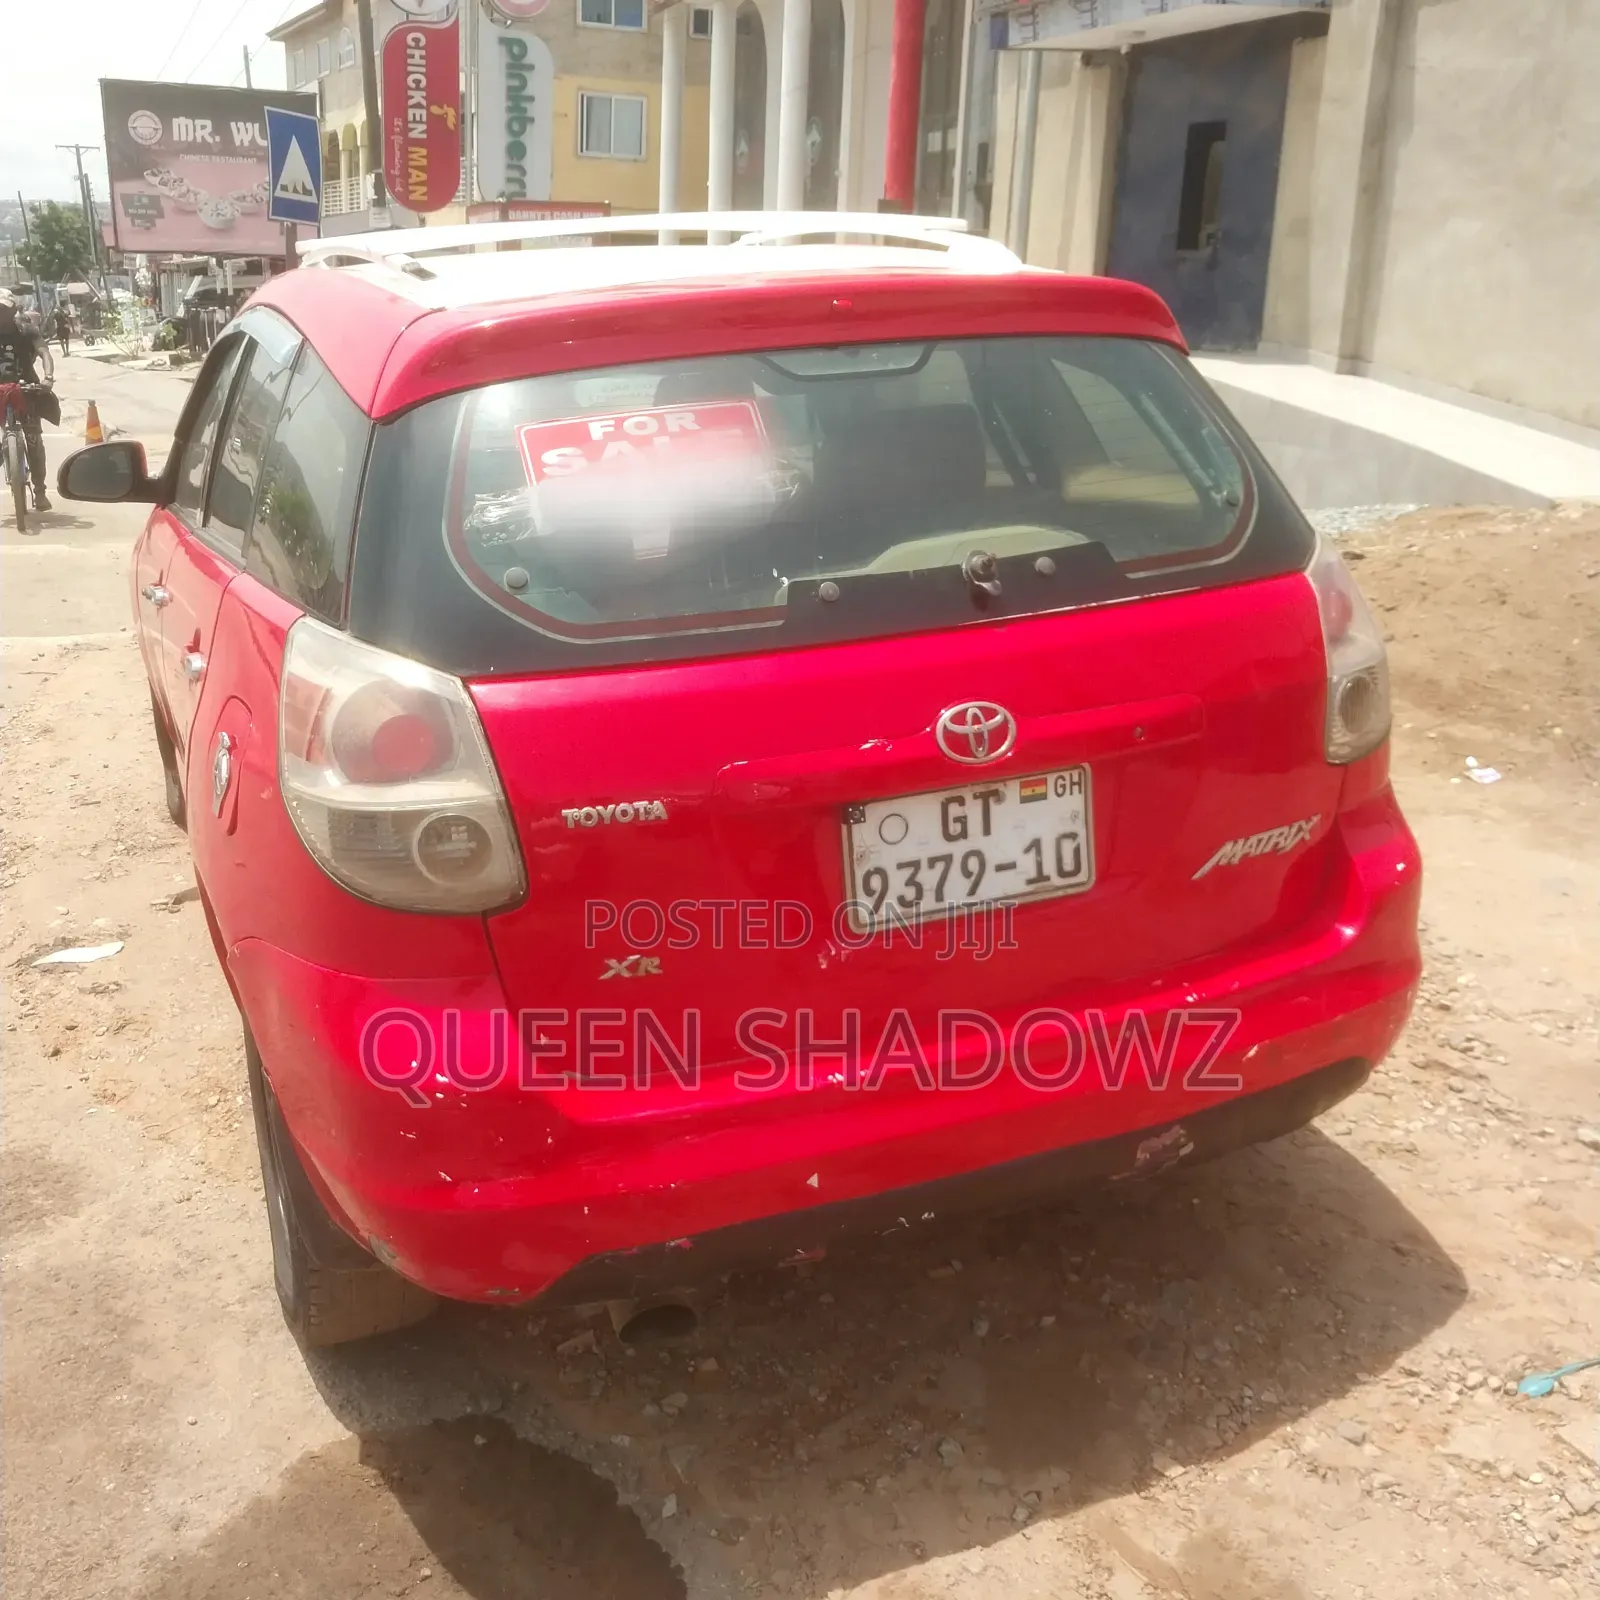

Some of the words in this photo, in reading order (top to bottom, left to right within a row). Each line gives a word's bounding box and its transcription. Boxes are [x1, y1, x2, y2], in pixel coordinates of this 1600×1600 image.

[406, 32, 427, 139] CHICKEN
[172, 116, 220, 144] MR.
[407, 147, 428, 201] MAN
[588, 412, 701, 441] FOR
[1054, 772, 1083, 798] GH
[562, 801, 668, 828] TOYOTA
[941, 789, 1000, 842] GT
[1191, 813, 1321, 880] MATRIX
[862, 832, 1081, 917] 9379-10
[598, 955, 663, 980] XR
